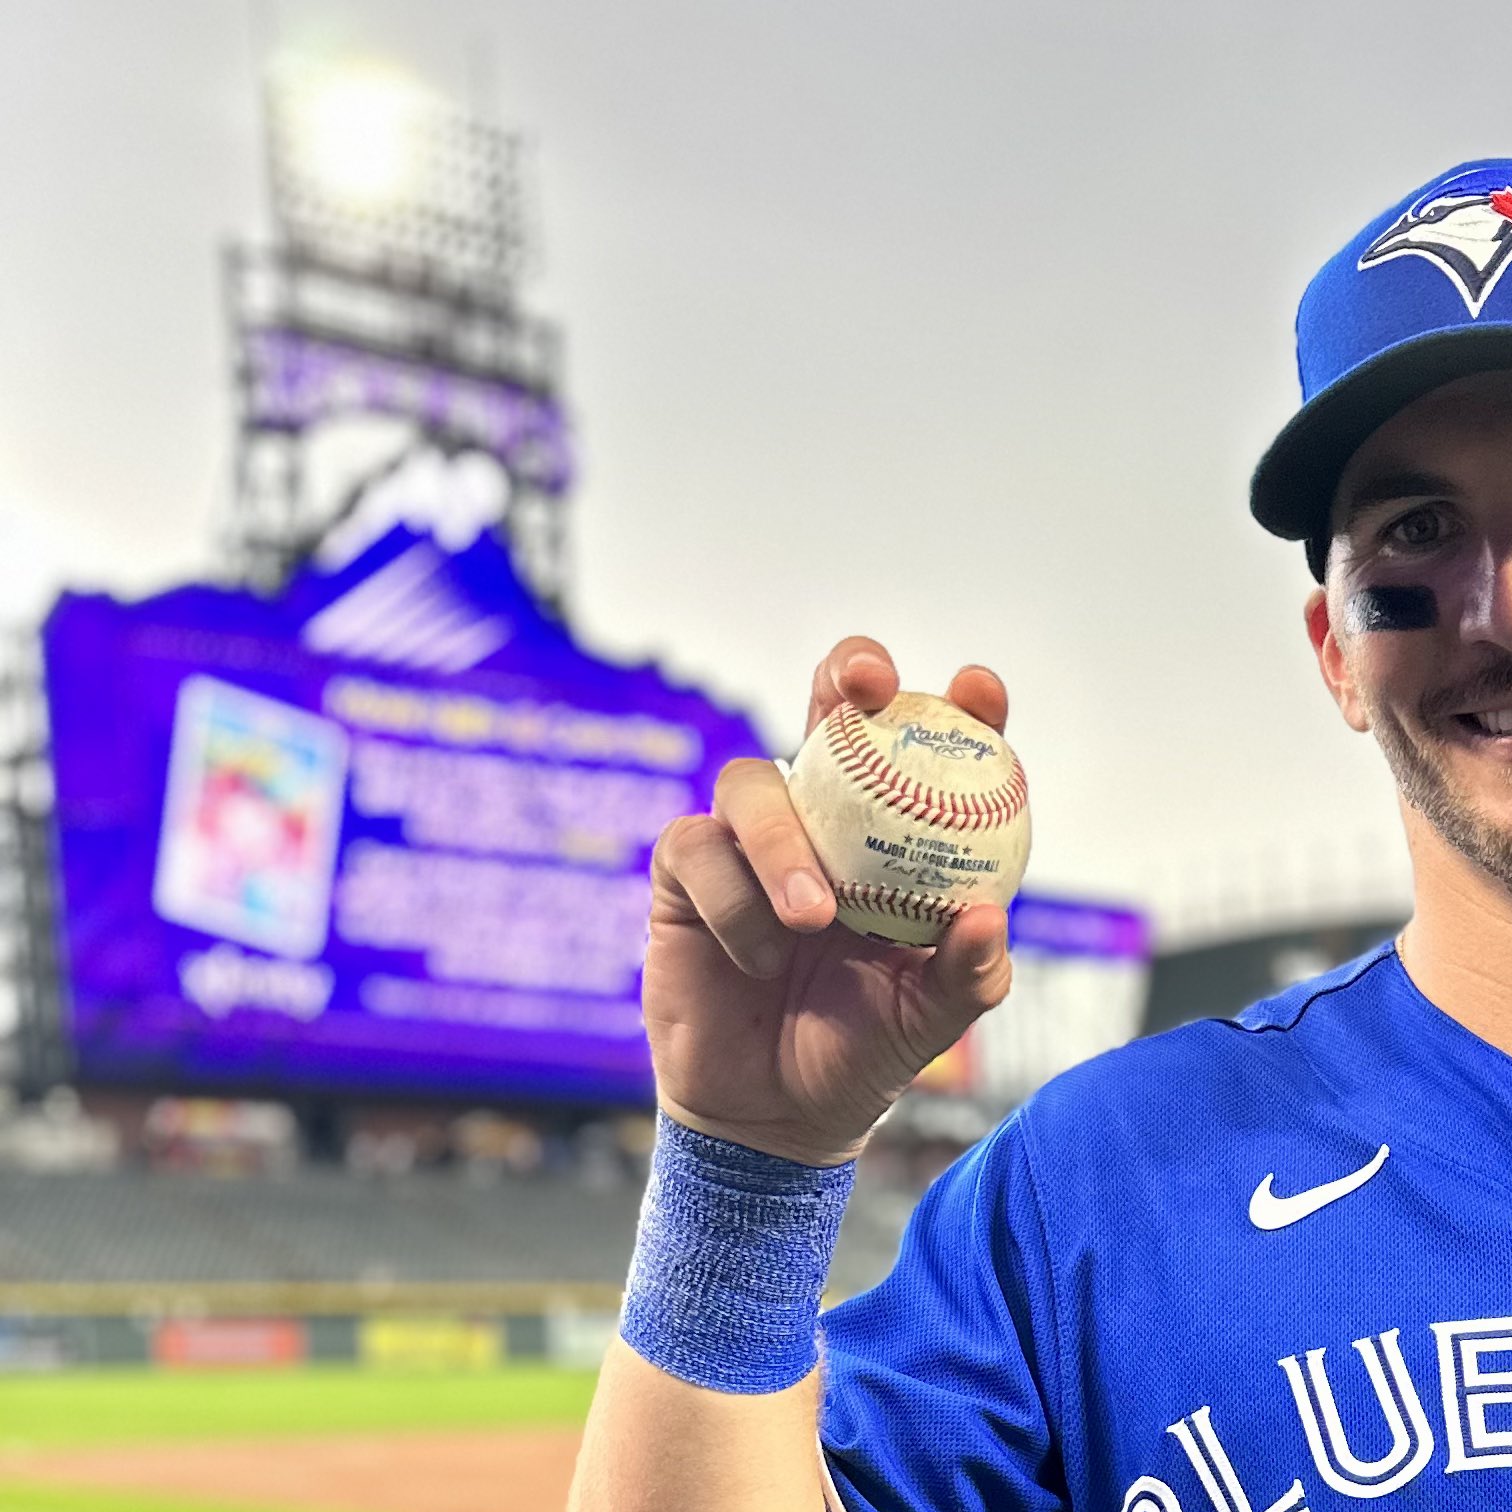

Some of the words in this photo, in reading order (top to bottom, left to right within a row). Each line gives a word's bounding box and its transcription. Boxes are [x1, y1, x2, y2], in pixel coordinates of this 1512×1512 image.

[898, 722, 998, 761] Rawlings
[864, 835, 907, 859] MAJOR
[909, 849, 950, 868] LEAGUE
[949, 856, 1000, 873] BASEBALL
